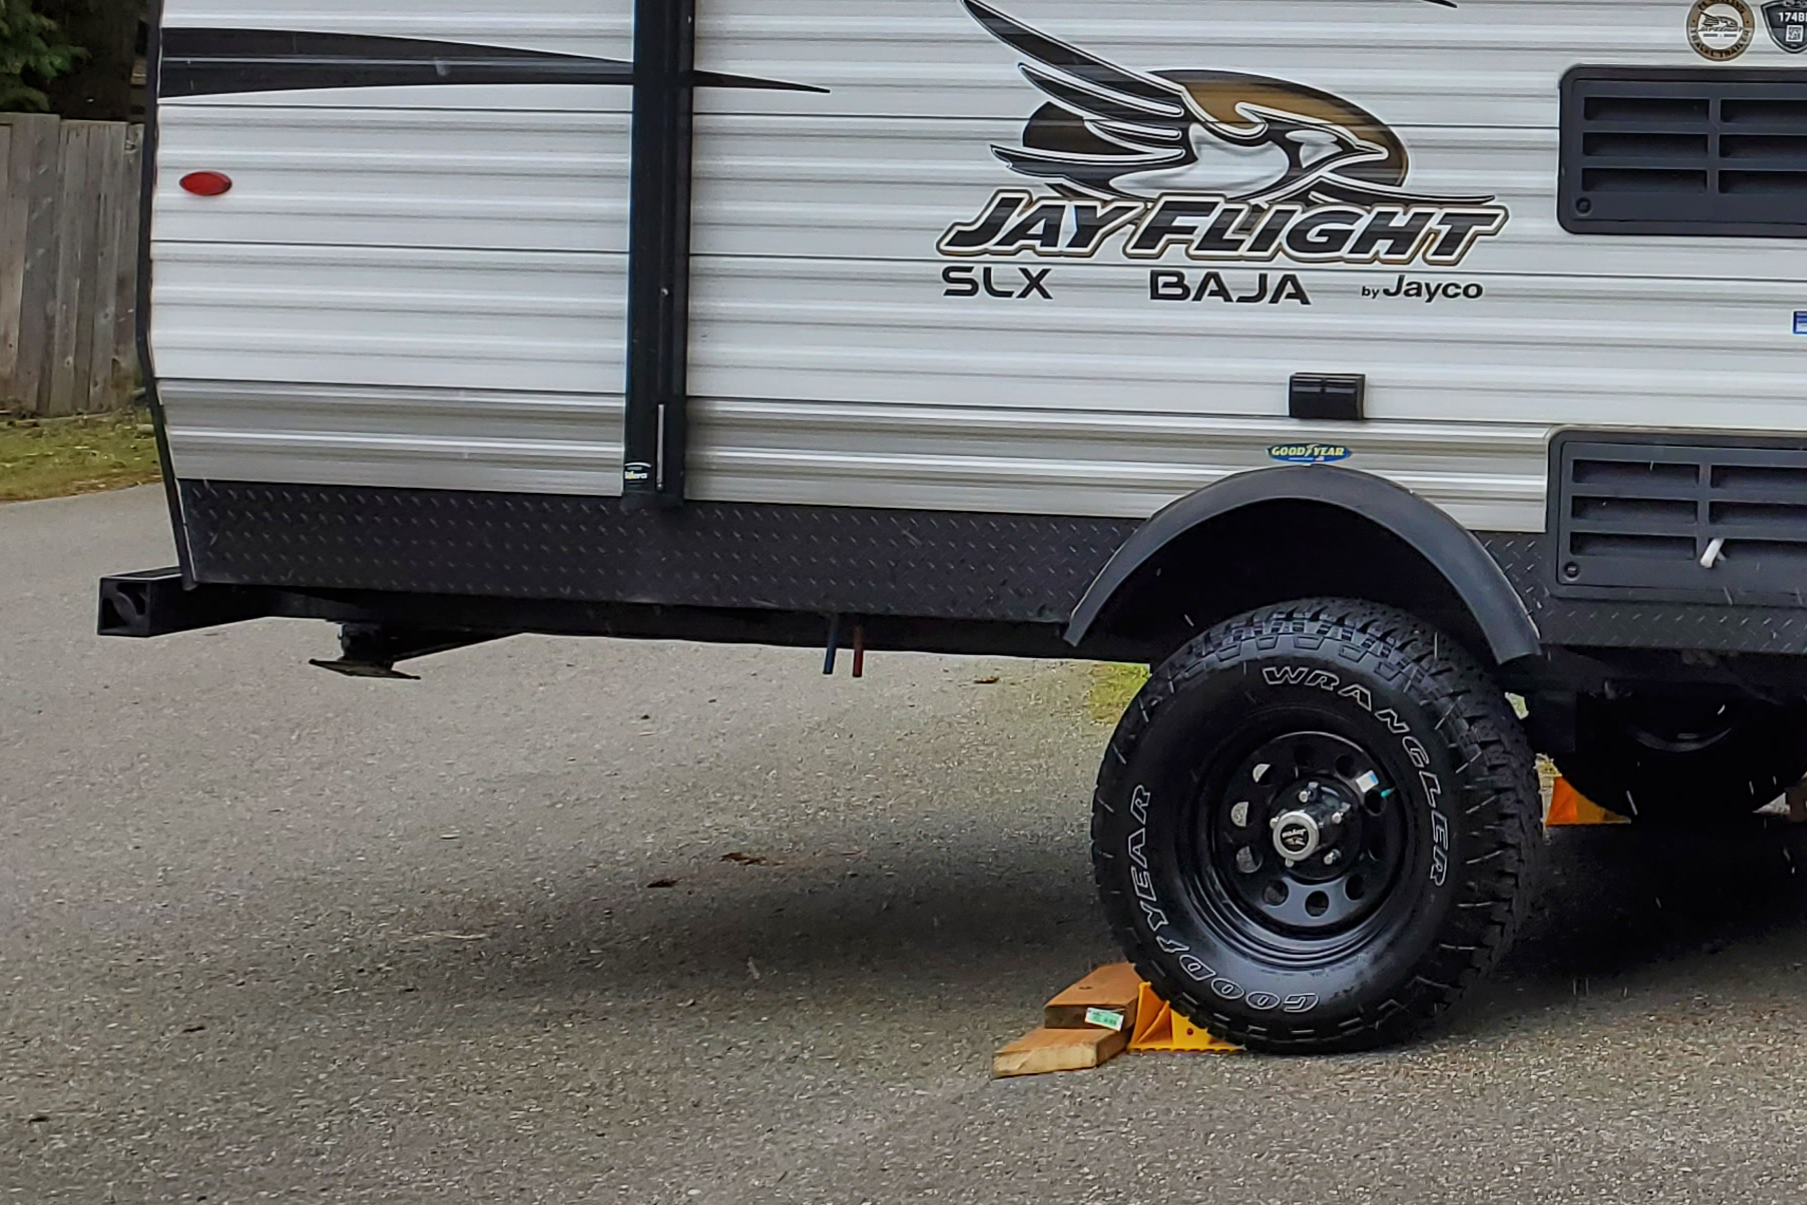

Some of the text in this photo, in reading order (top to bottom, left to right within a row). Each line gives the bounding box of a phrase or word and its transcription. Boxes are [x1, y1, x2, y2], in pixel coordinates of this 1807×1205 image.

[937, 190, 1509, 265] JAY FLIGHT
[941, 266, 1312, 305] SLX BAJA
[1361, 274, 1484, 304] by Jayco
[1262, 666, 1450, 887] WRANGLER
